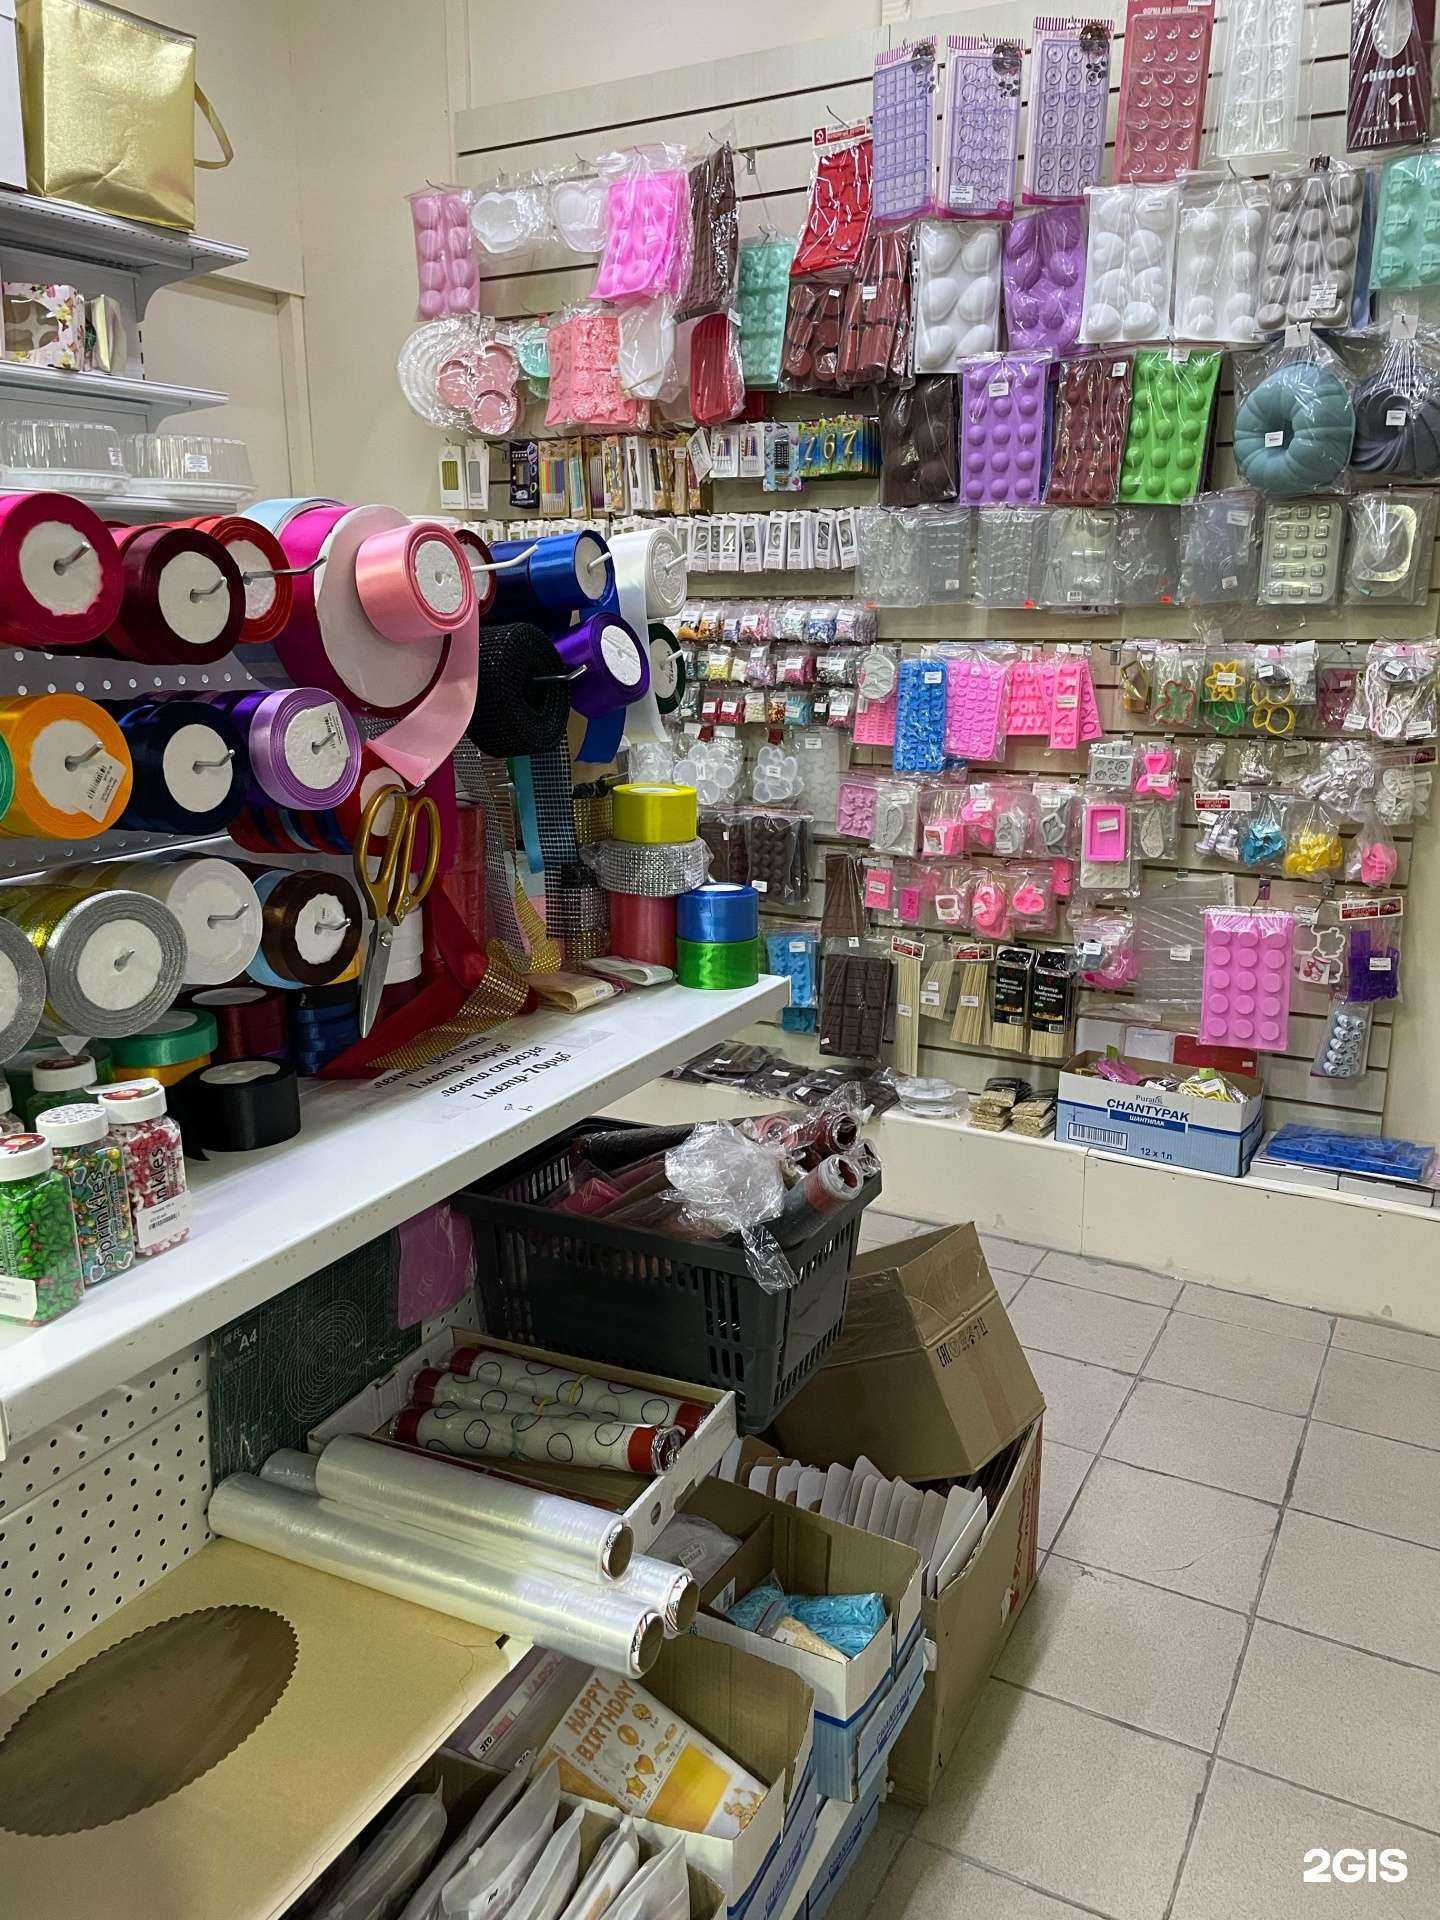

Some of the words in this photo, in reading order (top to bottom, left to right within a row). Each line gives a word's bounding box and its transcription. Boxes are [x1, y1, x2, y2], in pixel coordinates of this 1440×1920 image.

[722, 531, 736, 552] 4
[441, 1071, 489, 1097] лента
[489, 1045, 547, 1073] стразы
[1106, 1098, 1191, 1123] CHANTYPAK
[1140, 1147, 1151, 1156] 12
[90, 1168, 114, 1267] Sprinkles
[239, 1328, 258, 1352] A4
[565, 1677, 610, 1736] HAPPY
[575, 1679, 637, 1762] BIRTHDAY
